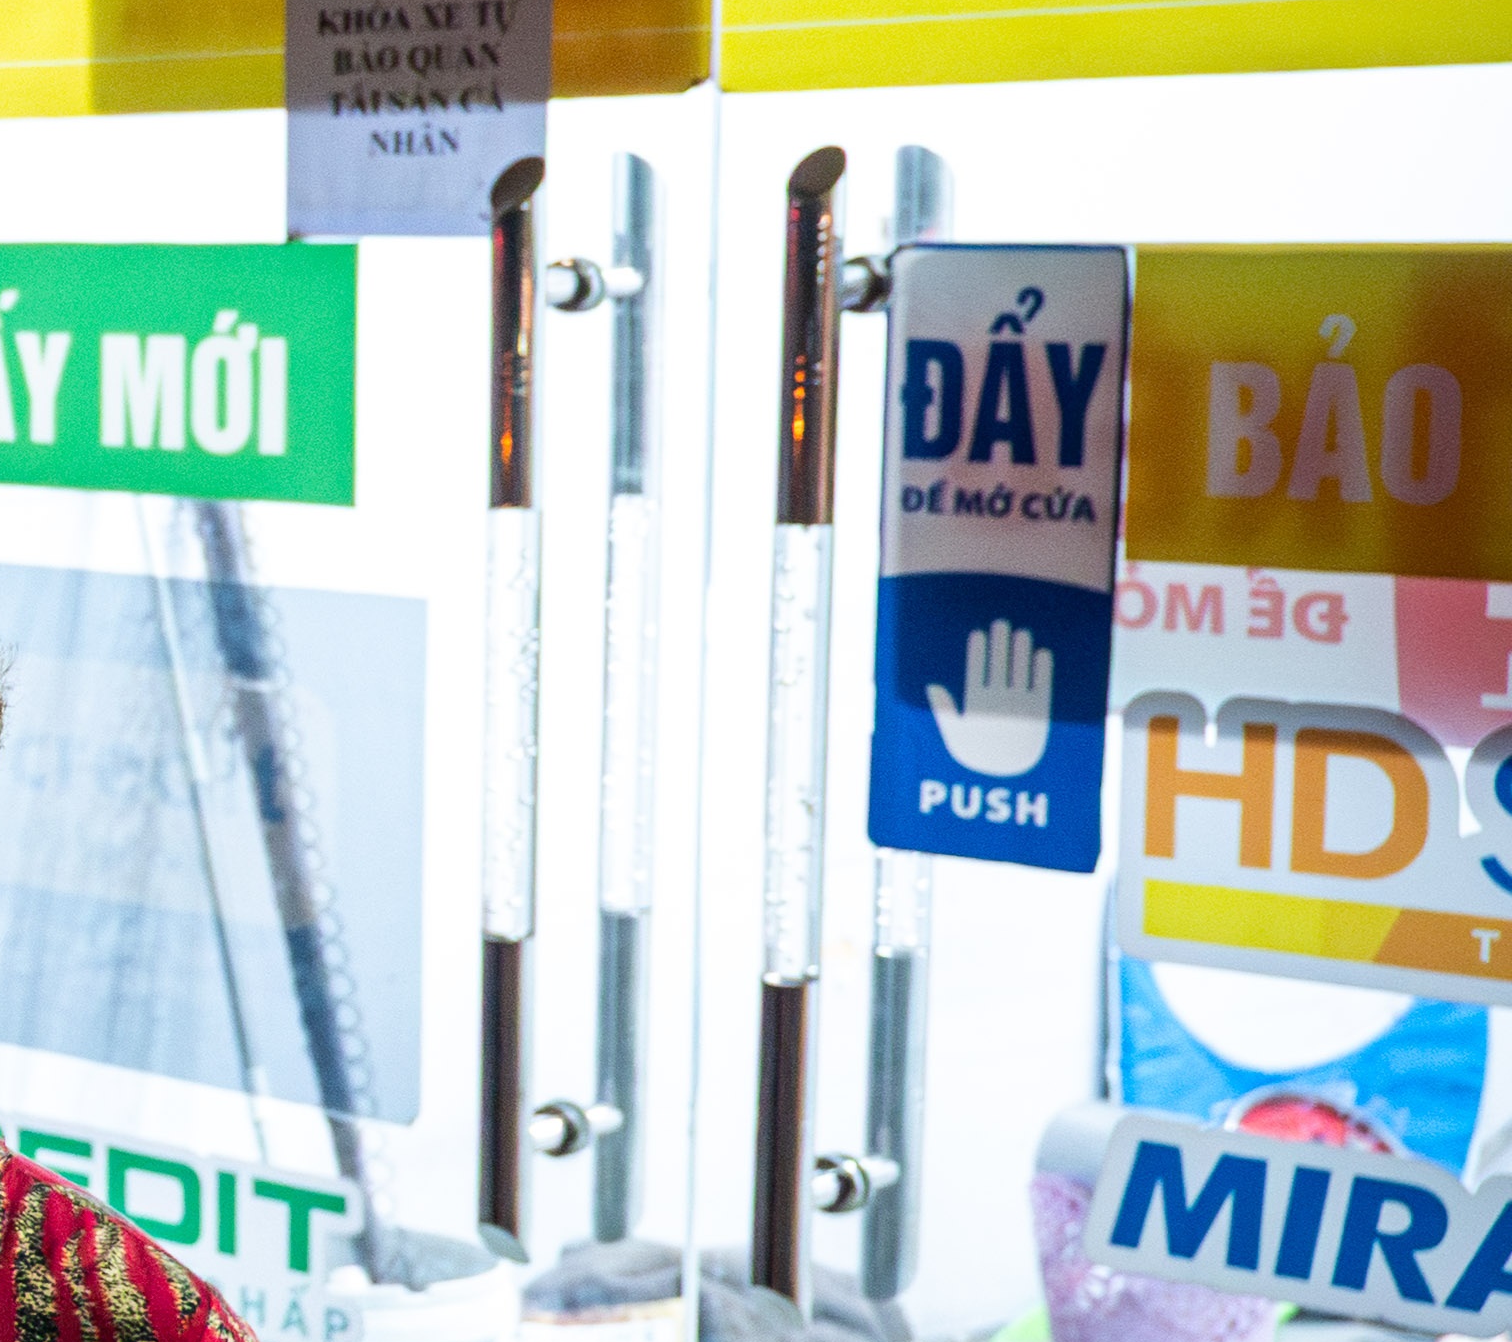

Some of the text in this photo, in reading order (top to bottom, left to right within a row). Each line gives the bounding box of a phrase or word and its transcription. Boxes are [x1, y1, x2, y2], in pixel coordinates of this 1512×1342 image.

[422, 2, 461, 32] XE
[98, 308, 290, 456] MỚI
[900, 287, 1107, 469] ĐẨY
[1206, 314, 1464, 506] BẢO
[952, 481, 1015, 519] MỞ
[1020, 485, 1098, 526] CỬA
[919, 778, 1049, 828] PUSH
